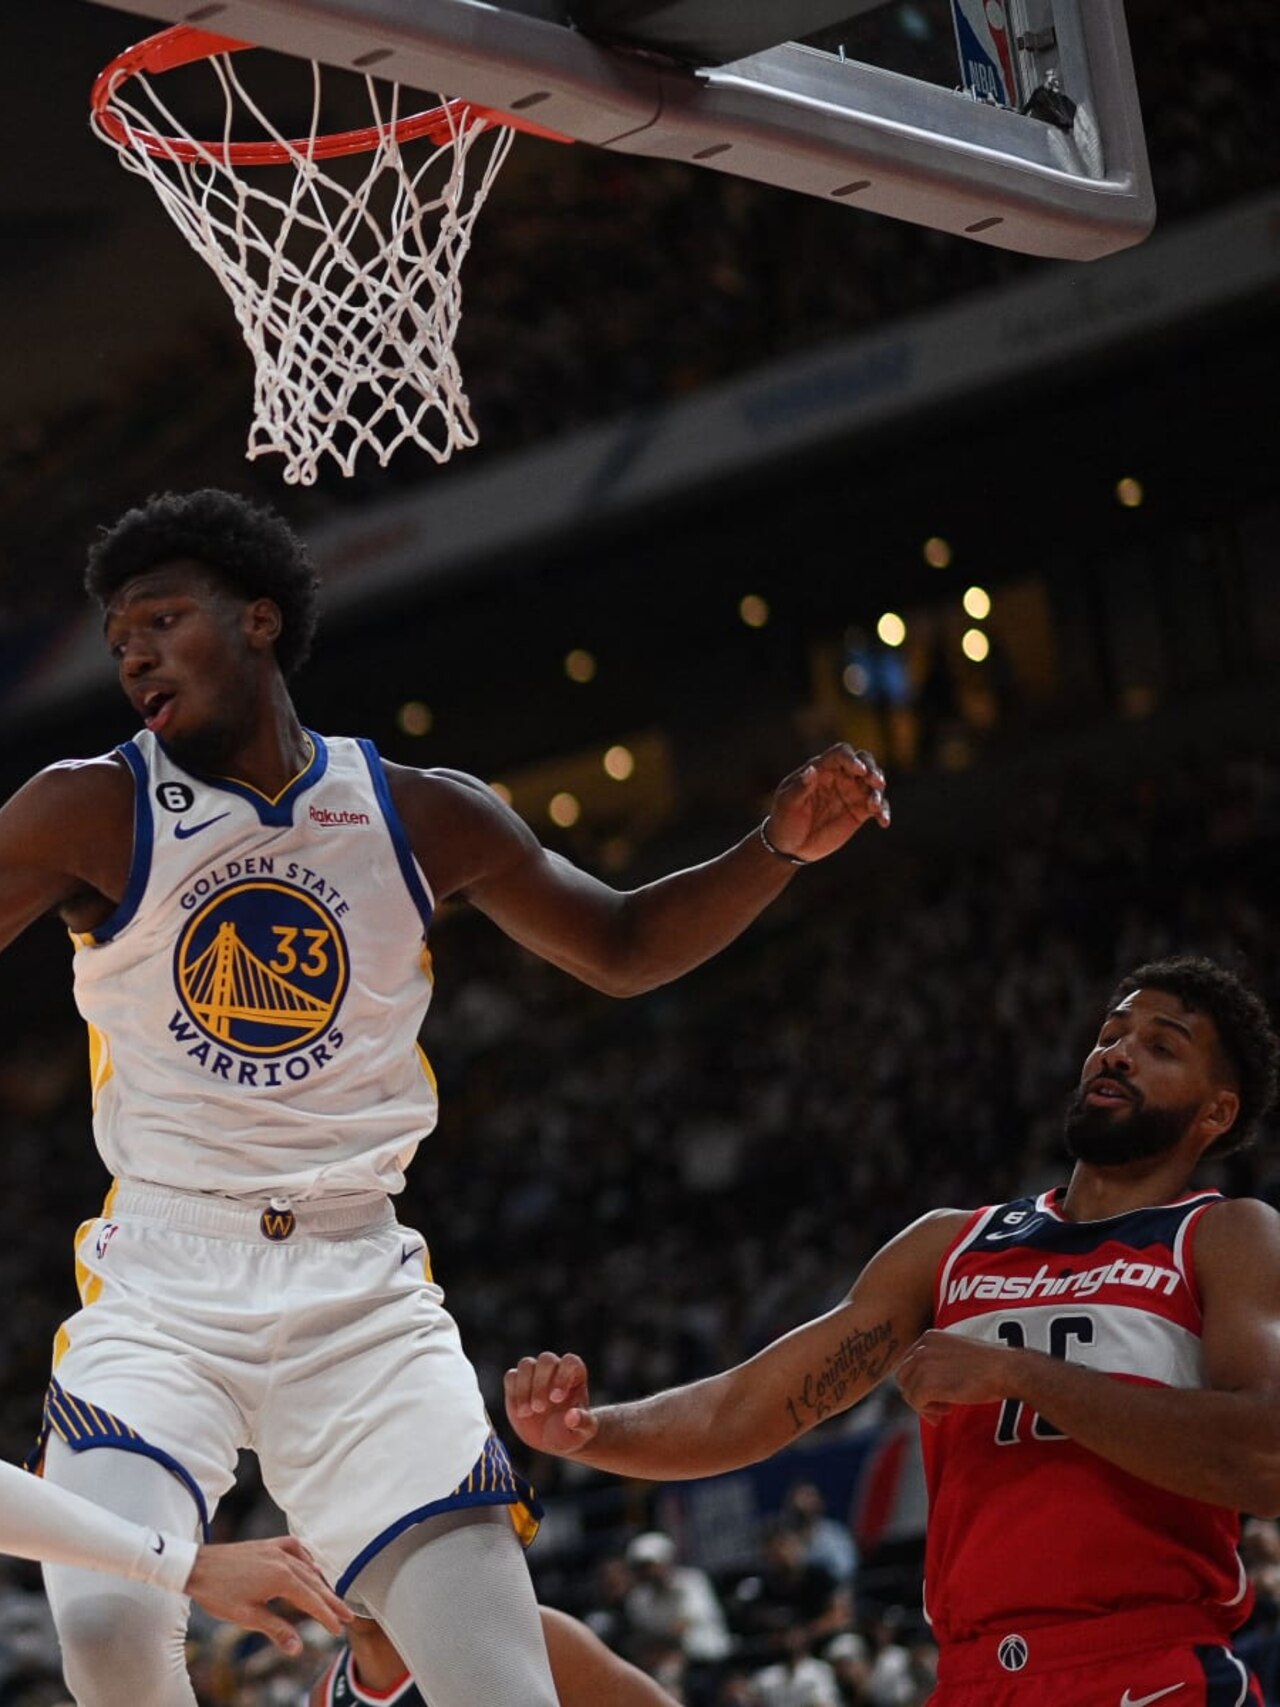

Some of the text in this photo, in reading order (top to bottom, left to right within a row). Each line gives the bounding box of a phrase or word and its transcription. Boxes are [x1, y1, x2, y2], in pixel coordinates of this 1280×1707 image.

[969, 60, 999, 97] NBA
[166, 784, 187, 810] 6
[309, 806, 370, 827] Rakuten
[180, 857, 351, 919] GOLDEN STATE
[269, 924, 330, 977] 33
[167, 1009, 346, 1087] WARRIORS
